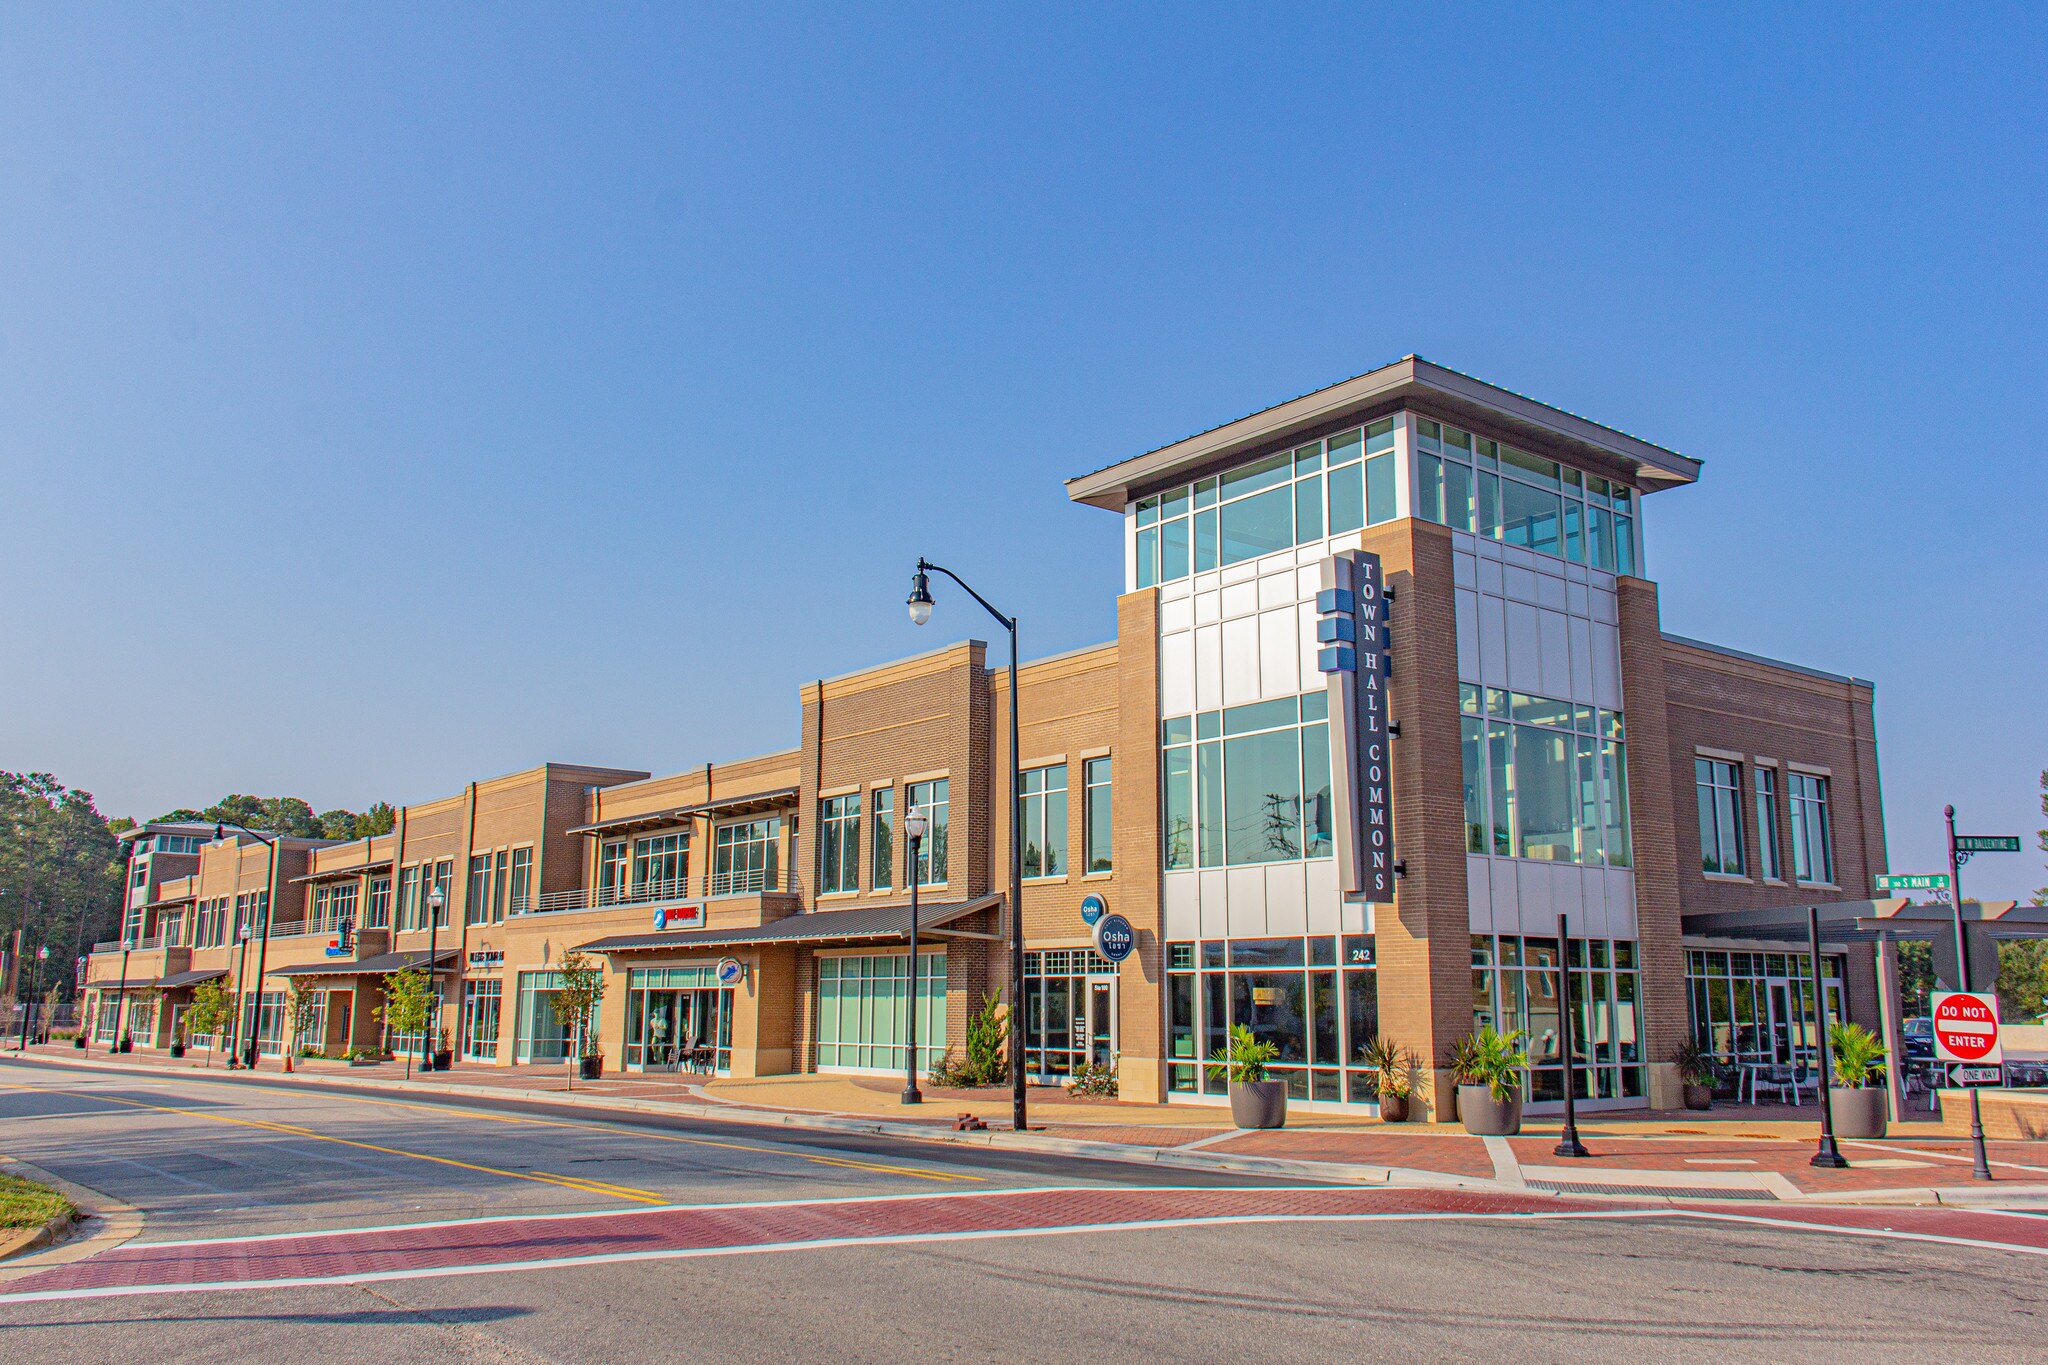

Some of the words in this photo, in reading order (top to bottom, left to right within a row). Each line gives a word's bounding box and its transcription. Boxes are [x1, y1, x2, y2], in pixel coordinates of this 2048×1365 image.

[1361, 562, 1377, 642] TOWN
[1364, 652, 1379, 732] HALL
[1368, 744, 1385, 890] COMMONS
[1902, 877, 1908, 888] S
[1910, 876, 1931, 888] MAIN
[1083, 905, 1098, 913] Osha
[1103, 931, 1130, 942] Osha
[1352, 949, 1371, 961] 242
[1941, 1005, 1958, 1017] DO
[1962, 1006, 1986, 1018] NOT
[1948, 1035, 1985, 1048] ENTER
[1963, 1069, 1980, 1081] ONE
[1980, 1069, 1997, 1080] WAY
